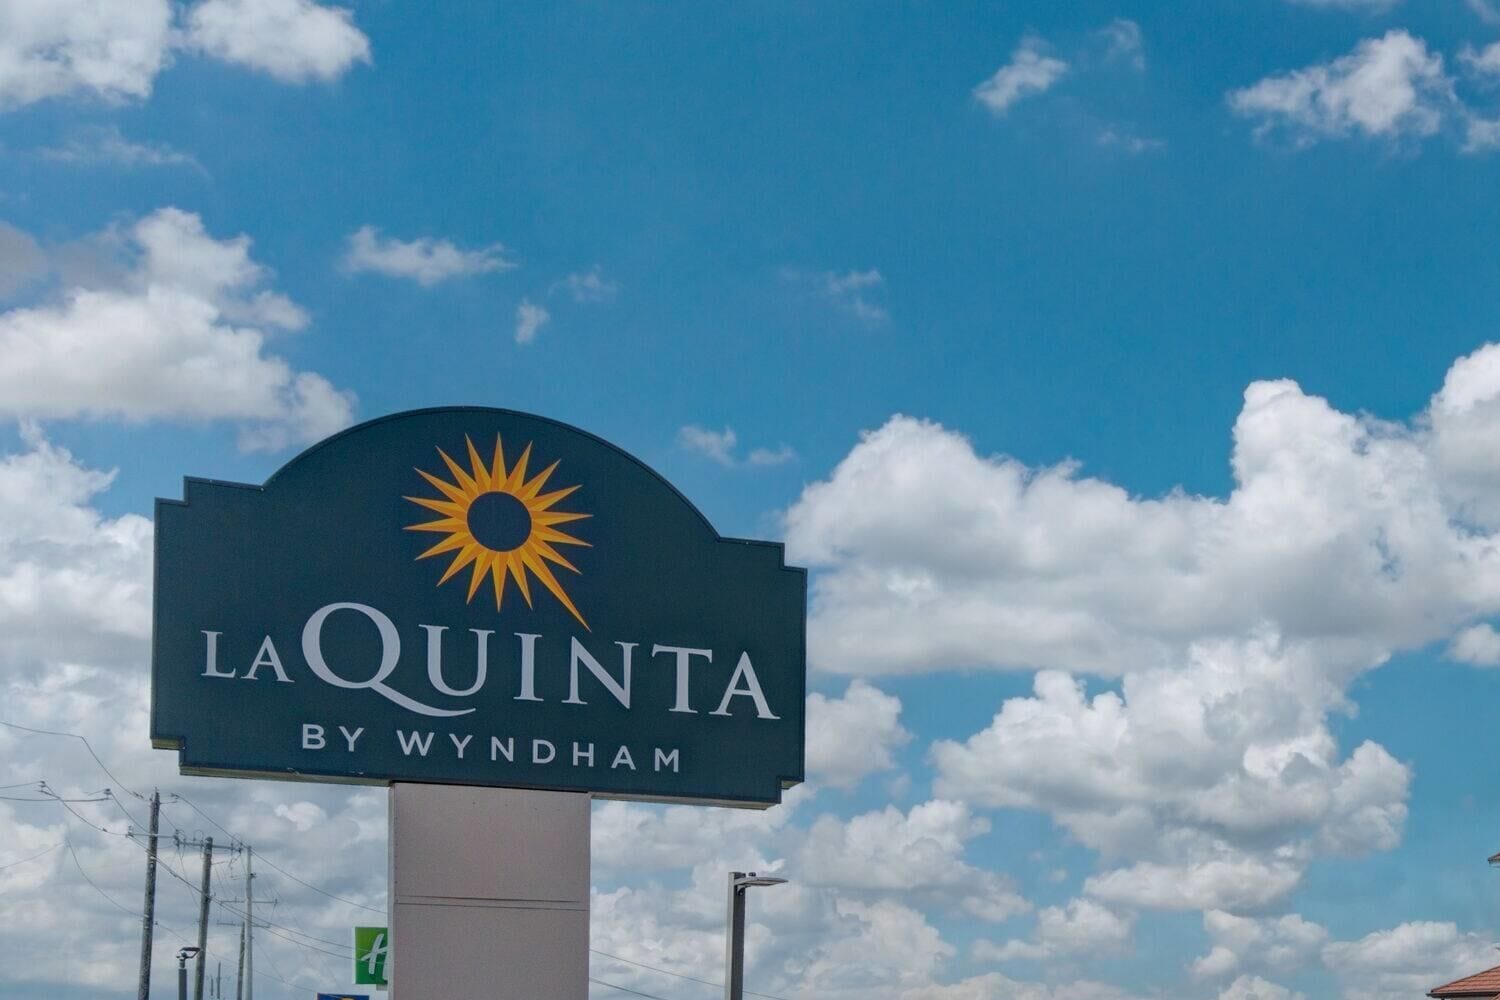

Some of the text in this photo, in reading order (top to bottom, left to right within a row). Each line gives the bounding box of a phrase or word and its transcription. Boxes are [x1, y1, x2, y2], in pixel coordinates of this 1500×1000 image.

[201, 601, 781, 721] LA QUINTA
[302, 723, 682, 774] BY WYNDHAM
